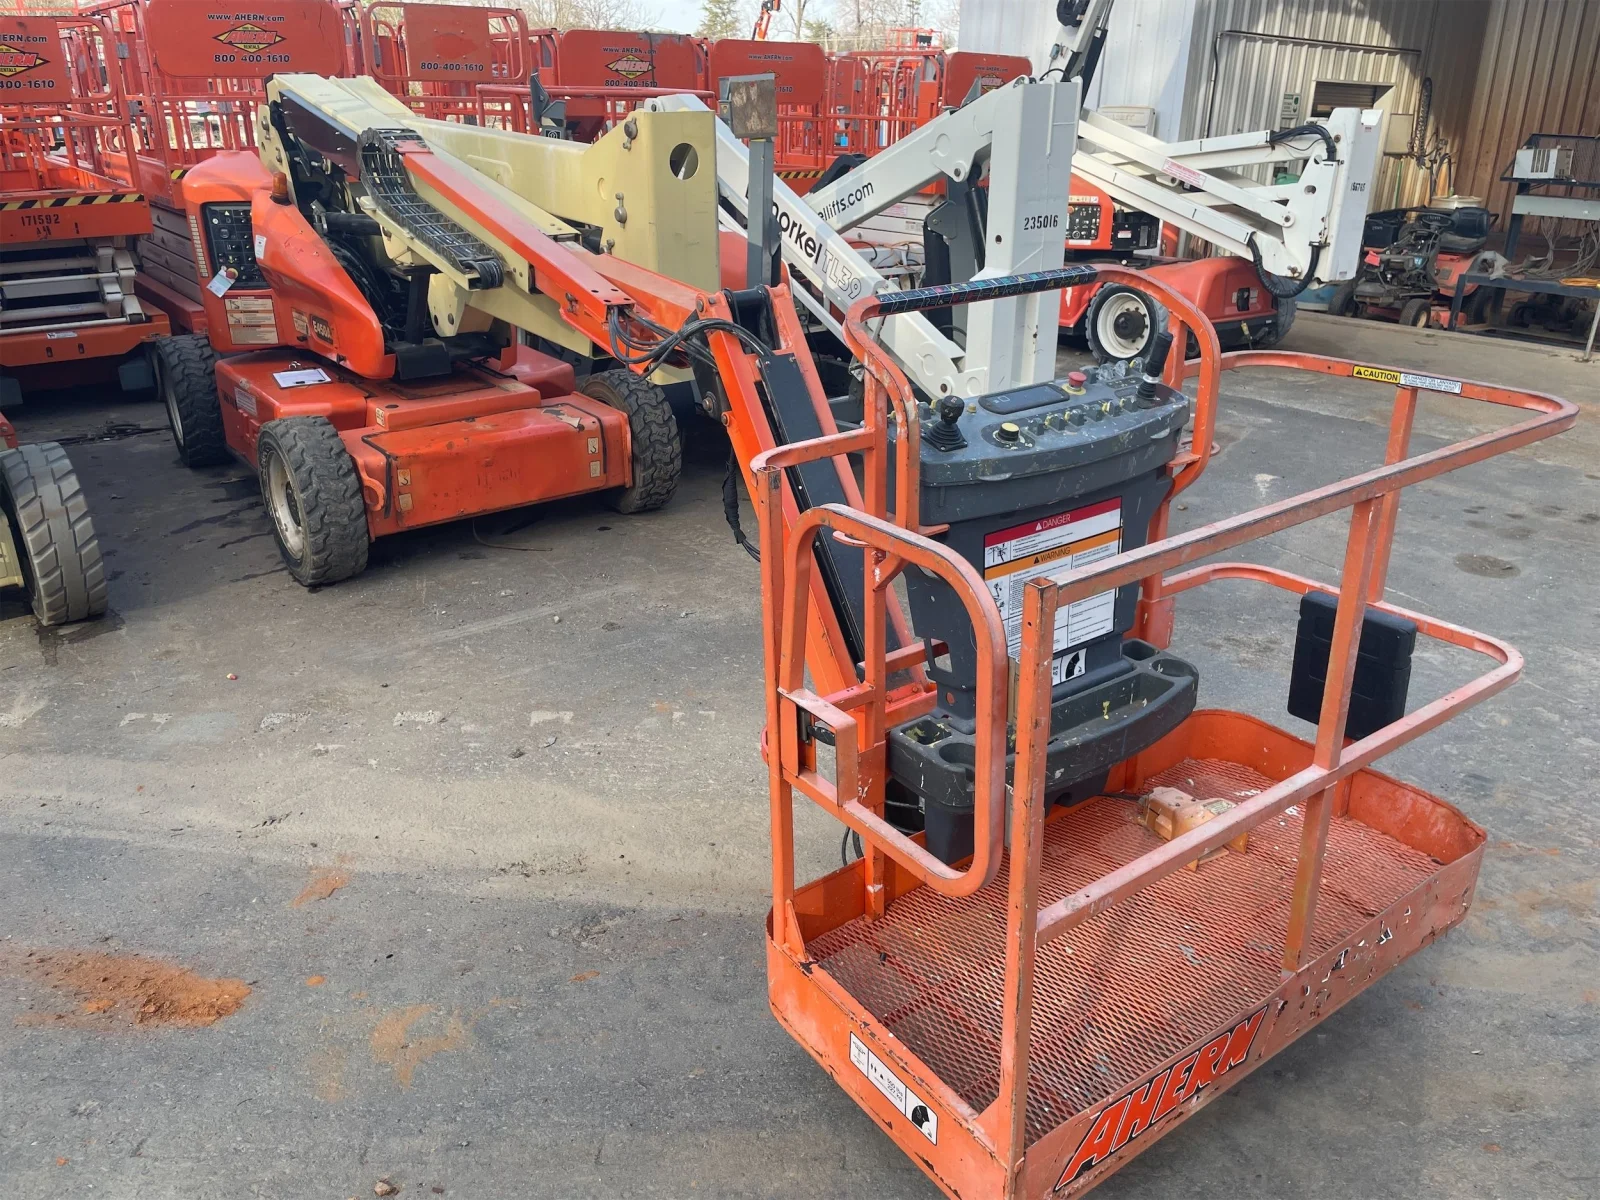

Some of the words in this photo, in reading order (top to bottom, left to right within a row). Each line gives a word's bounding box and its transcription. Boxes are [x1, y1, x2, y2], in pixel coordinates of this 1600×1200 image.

[0, 34, 47, 42] ERN.com
[1023, 214, 1059, 230] 235016
[771, 201, 823, 265] norkel
[821, 248, 862, 300] TL39
[1363, 369, 1398, 382] CAUTION
[1042, 513, 1071, 529] DANGER
[1040, 547, 1071, 562] WARNING
[1054, 1005, 1268, 1192] AHERN
